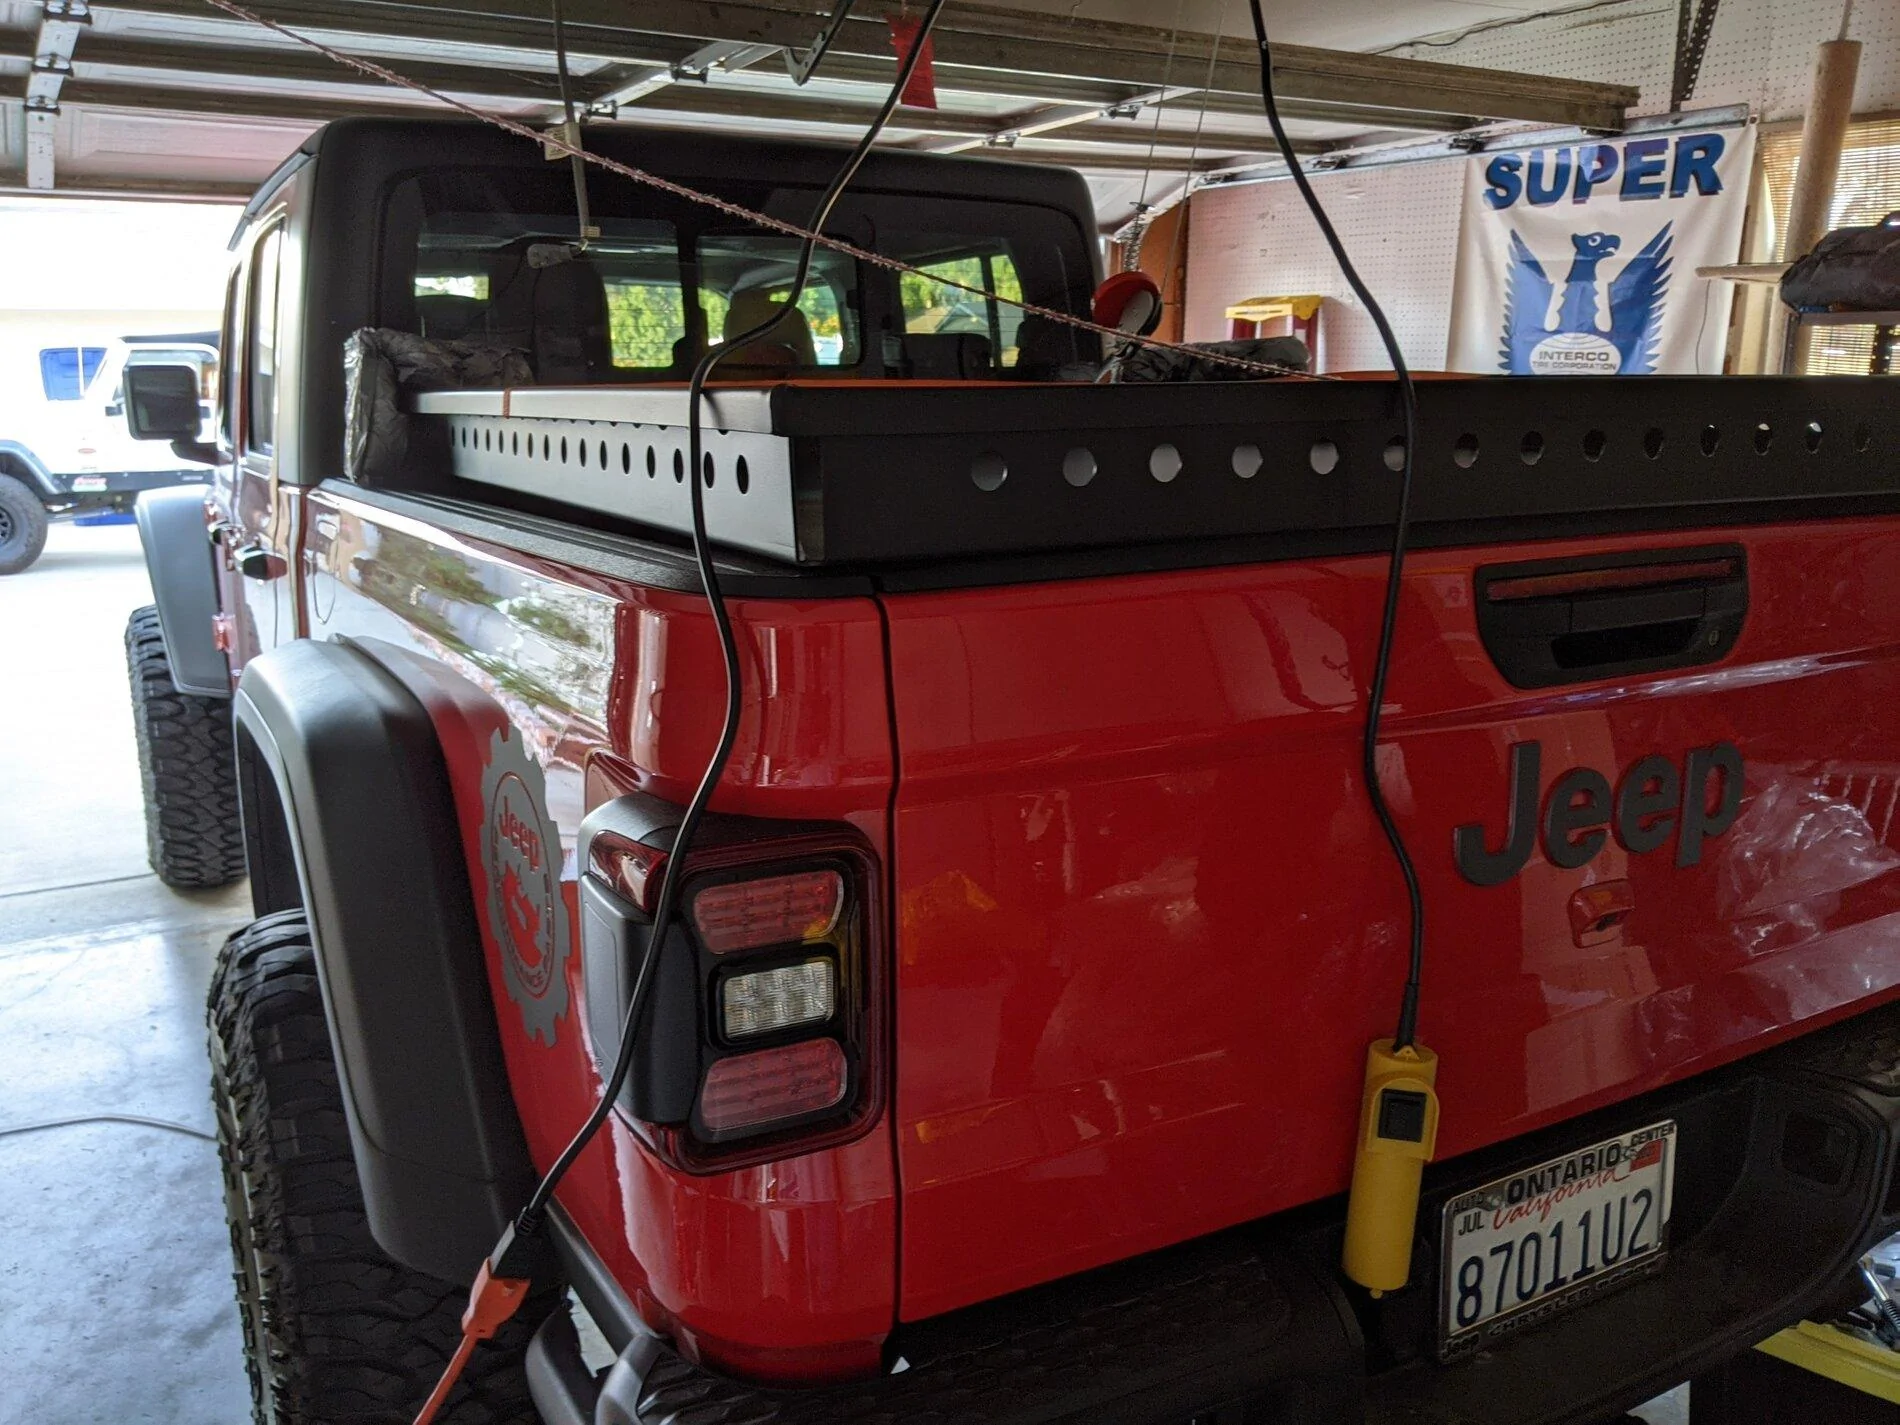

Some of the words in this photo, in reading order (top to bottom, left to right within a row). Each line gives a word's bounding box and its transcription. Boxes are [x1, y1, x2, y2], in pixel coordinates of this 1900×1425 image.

[1482, 133, 1724, 210] SUPER
[1539, 351, 1610, 362] INTERCO
[1552, 361, 1616, 371] CORPORATION
[1454, 740, 1744, 886] Jeep
[1631, 1124, 1675, 1147] CENTER
[1508, 1142, 1622, 1205] ONTARIO
[1459, 1211, 1484, 1237] JUL
[1457, 1188, 1652, 1328] 87011U2
